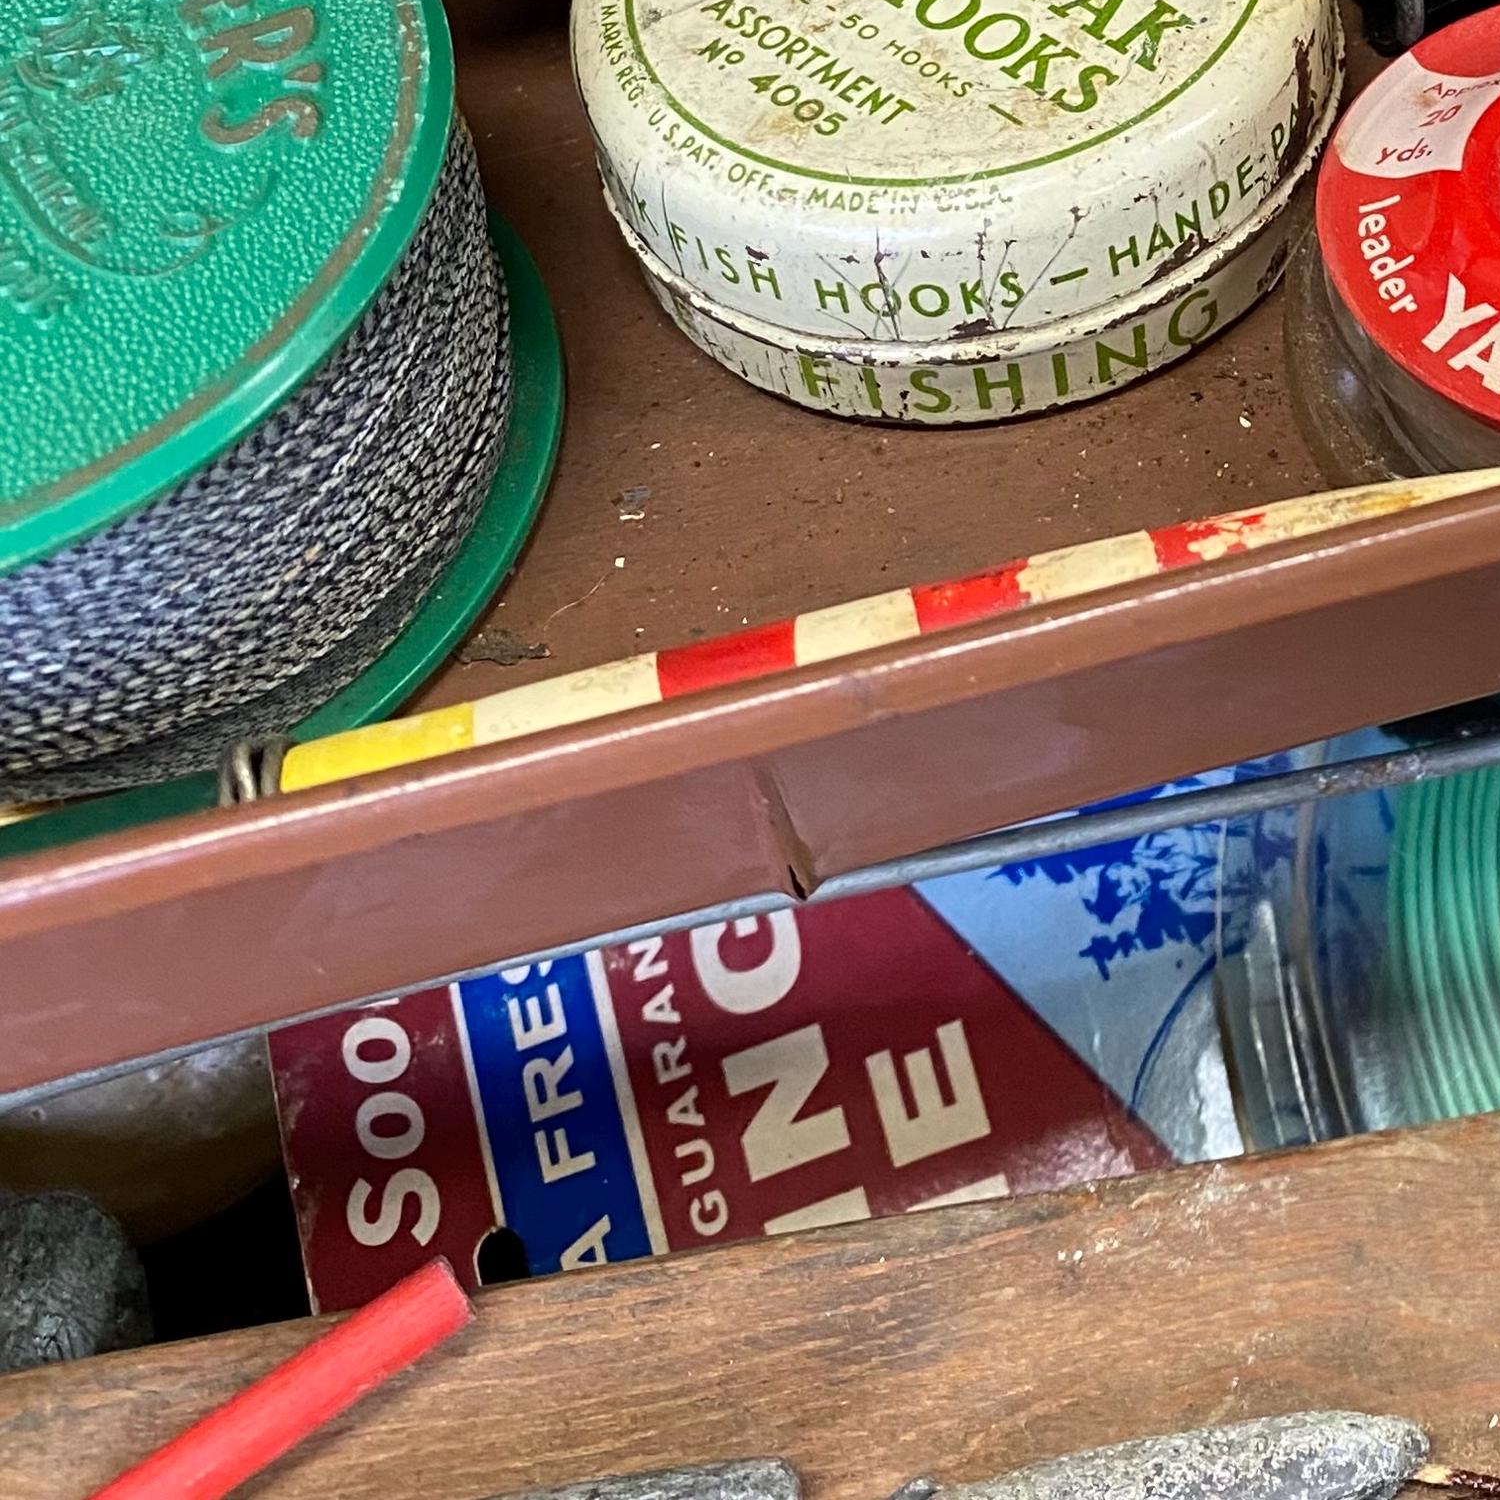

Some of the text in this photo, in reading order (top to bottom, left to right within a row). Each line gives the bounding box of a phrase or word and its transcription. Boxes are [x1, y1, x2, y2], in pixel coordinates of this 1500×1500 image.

[600, 3, 628, 65] MARKS
[807, 187, 880, 214] MADE
[888, 190, 919, 215] IN
[749, 74, 849, 136] 4005
[840, 13, 880, 40] 50
[883, 40, 974, 98] HOOKS
[1419, 104, 1462, 128] 20
[670, 102, 1302, 319] FISH HOOKS HANDE-PA
[1376, 145, 1434, 166] yds.
[1357, 194, 1418, 315] leader
[800, 288, 1219, 415] FISHING
[341, 1000, 442, 1249] SOO
[627, 936, 729, 1237] GUARAN
